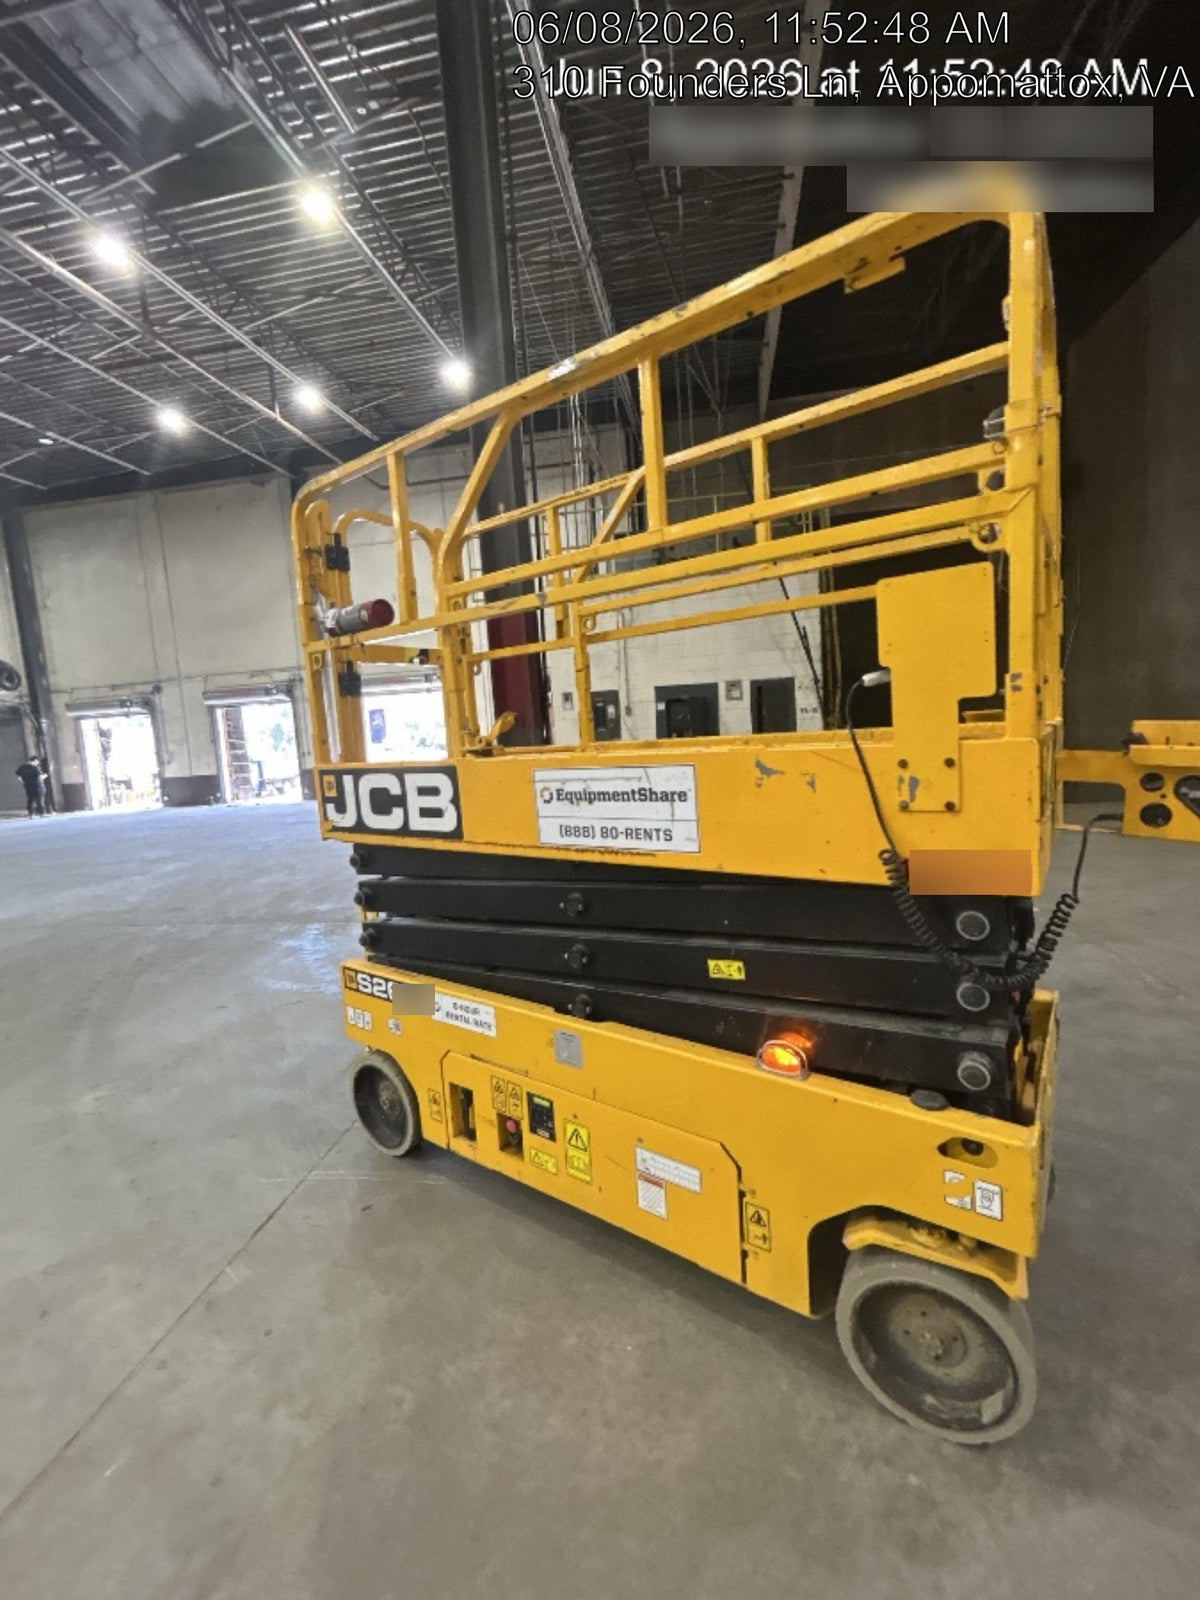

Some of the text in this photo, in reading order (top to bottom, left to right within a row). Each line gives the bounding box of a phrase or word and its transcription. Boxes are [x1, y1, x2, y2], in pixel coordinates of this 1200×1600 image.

[325, 773, 457, 832] JCB
[555, 787, 688, 805] EquipmentShare
[559, 824, 673, 842] (888) 80-RENTS
